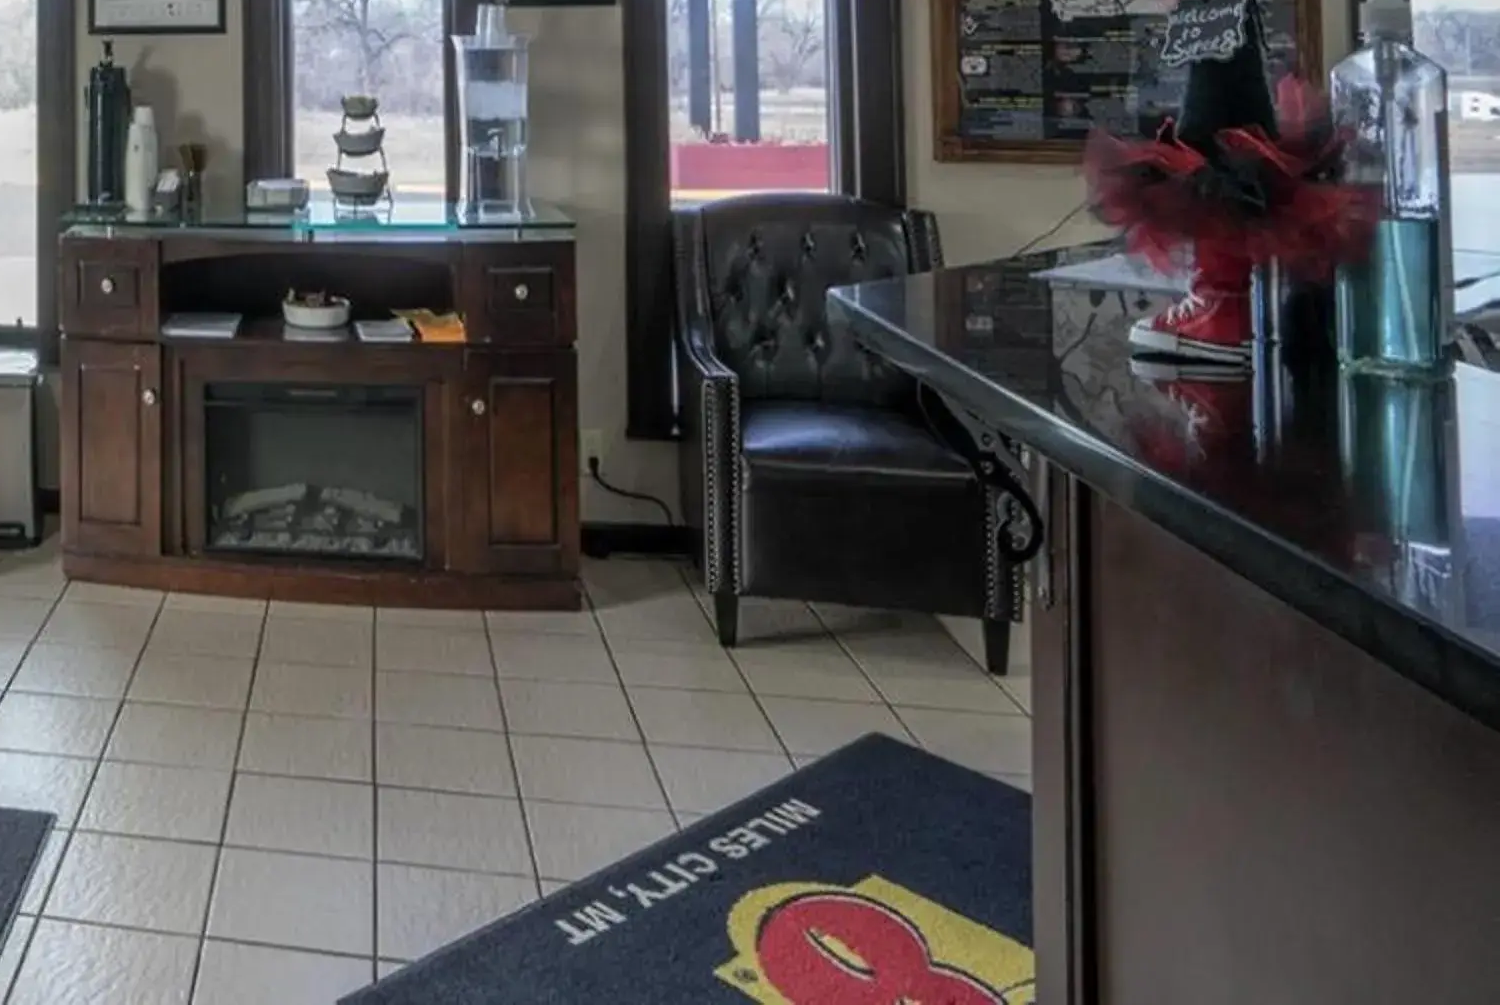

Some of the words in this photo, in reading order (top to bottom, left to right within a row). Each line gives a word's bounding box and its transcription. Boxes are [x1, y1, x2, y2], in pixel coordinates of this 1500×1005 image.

[710, 798, 822, 860] MILES
[607, 850, 719, 909] CITY,
[554, 901, 628, 945] MT
